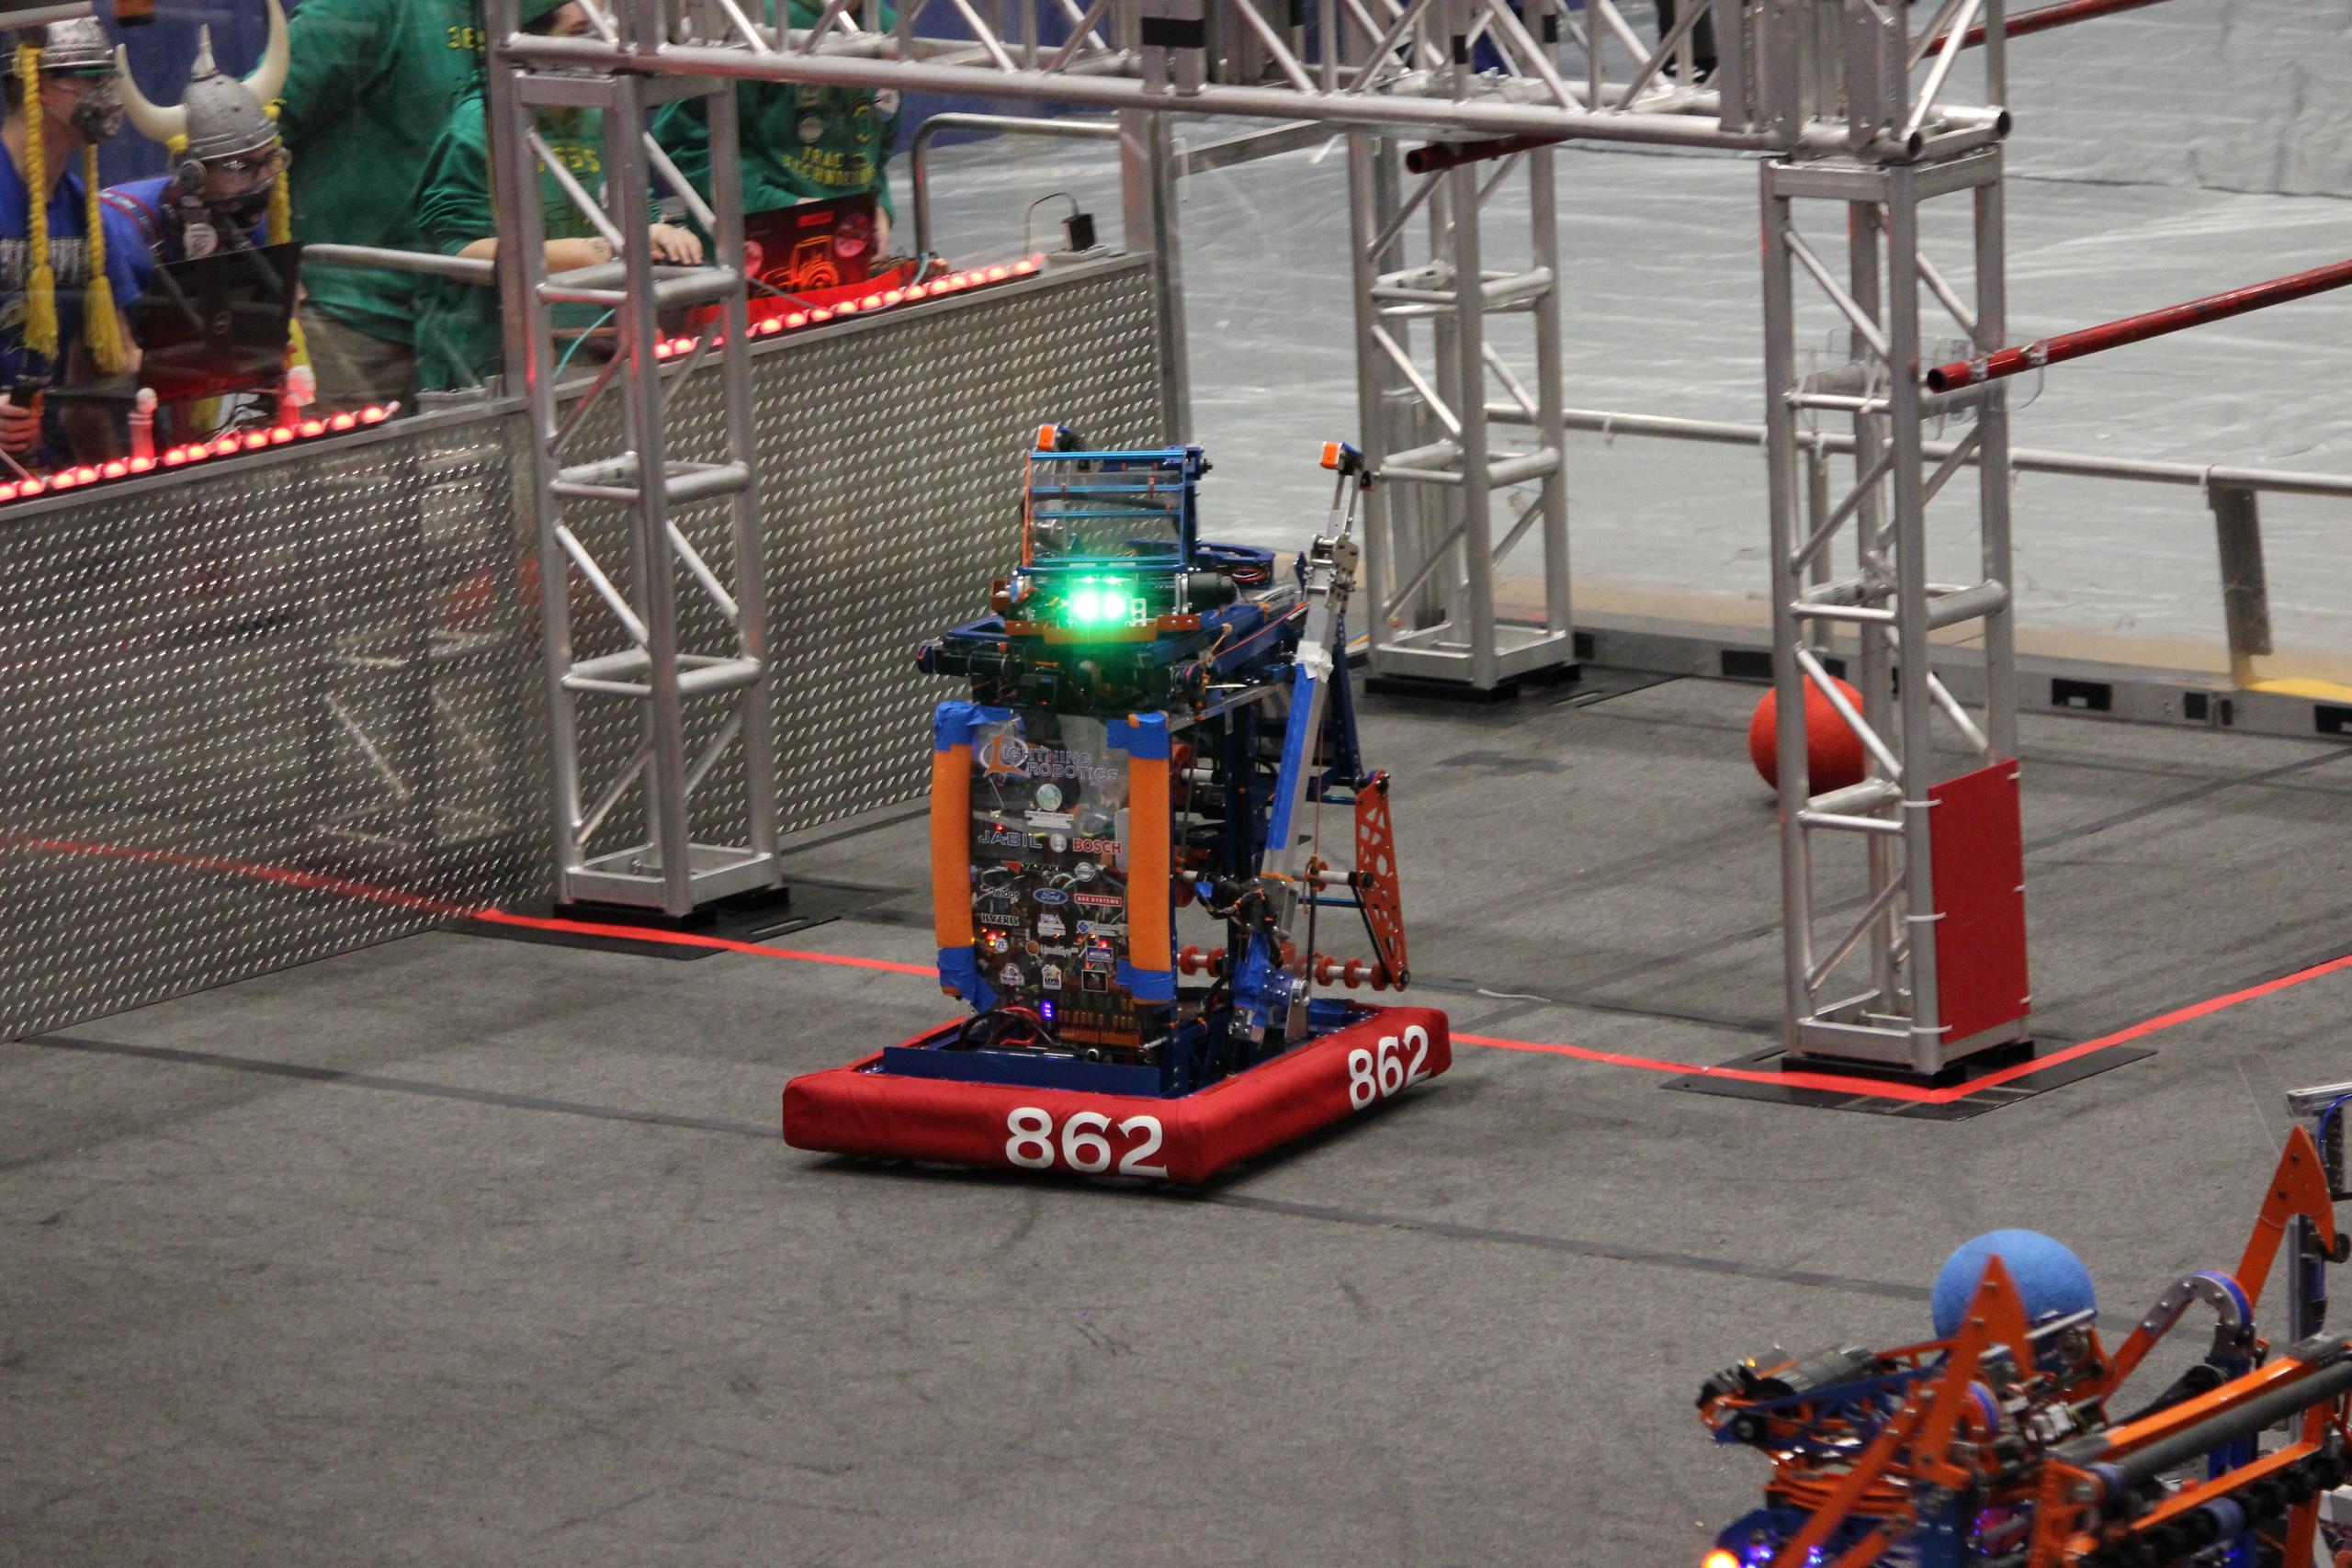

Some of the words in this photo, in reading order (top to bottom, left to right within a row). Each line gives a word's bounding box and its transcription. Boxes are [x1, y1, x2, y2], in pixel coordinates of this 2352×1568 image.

[1027, 762, 1120, 782] ROBOTICS
[978, 829, 1043, 849] JABIL
[1073, 838, 1122, 854] BOSCH
[1022, 863, 1061, 873] YAZAKI
[992, 888, 1021, 899] leidos
[1040, 890, 1061, 902] Ford
[1348, 1024, 1432, 1111] 862
[1005, 1107, 1169, 1179] 862
